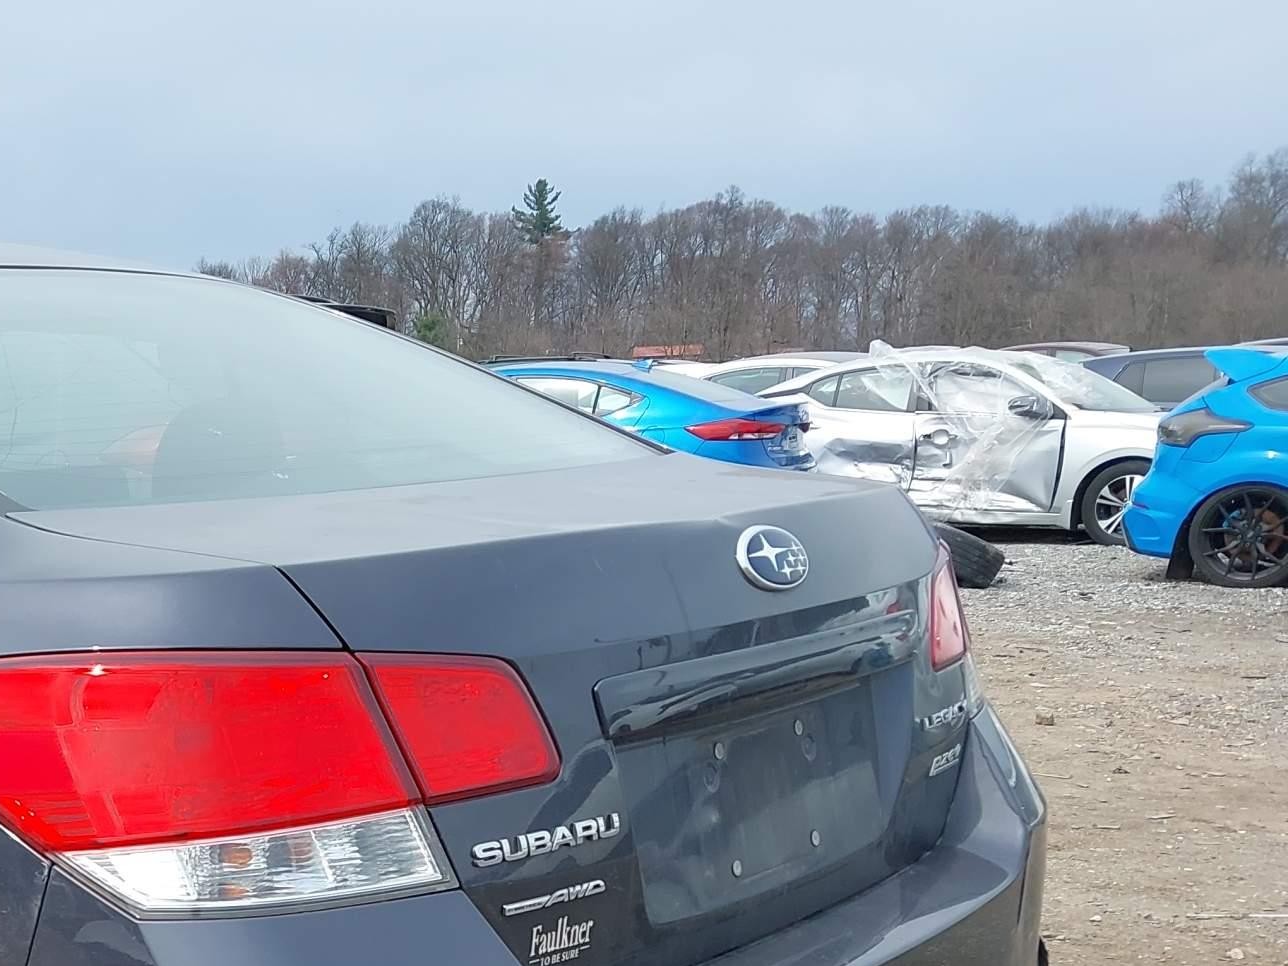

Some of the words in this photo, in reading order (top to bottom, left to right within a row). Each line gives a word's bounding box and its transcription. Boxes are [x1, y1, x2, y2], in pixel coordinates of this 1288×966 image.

[472, 812, 621, 868] SUBARU
[545, 879, 606, 908] AWD
[529, 915, 594, 957] Faulkner
[540, 956, 551, 966] TO
[551, 953, 561, 964] BE
[561, 947, 579, 962] SURE
